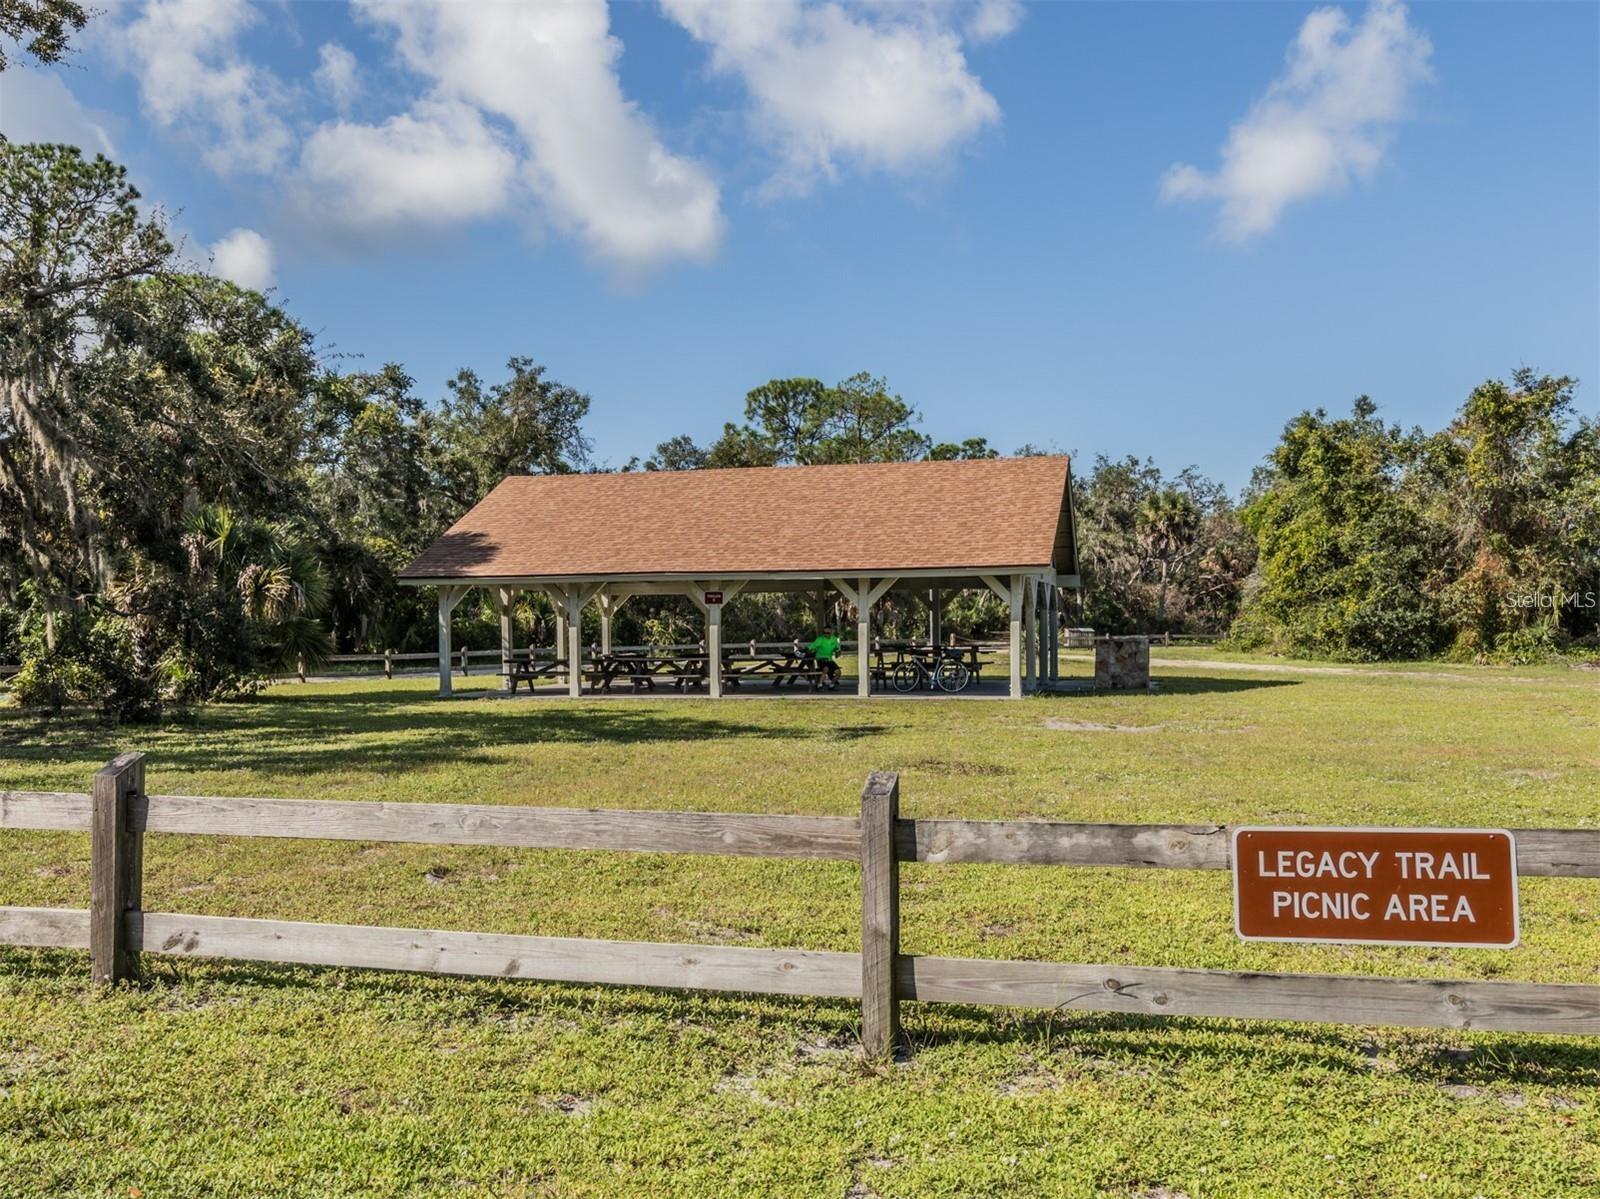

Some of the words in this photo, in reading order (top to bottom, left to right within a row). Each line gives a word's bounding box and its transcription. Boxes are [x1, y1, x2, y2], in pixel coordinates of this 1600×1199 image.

[1258, 850, 1380, 879] LEGACY
[1395, 852, 1490, 880] TRAIL
[1273, 891, 1370, 920] PICNIC
[1384, 893, 1476, 923] AREA
